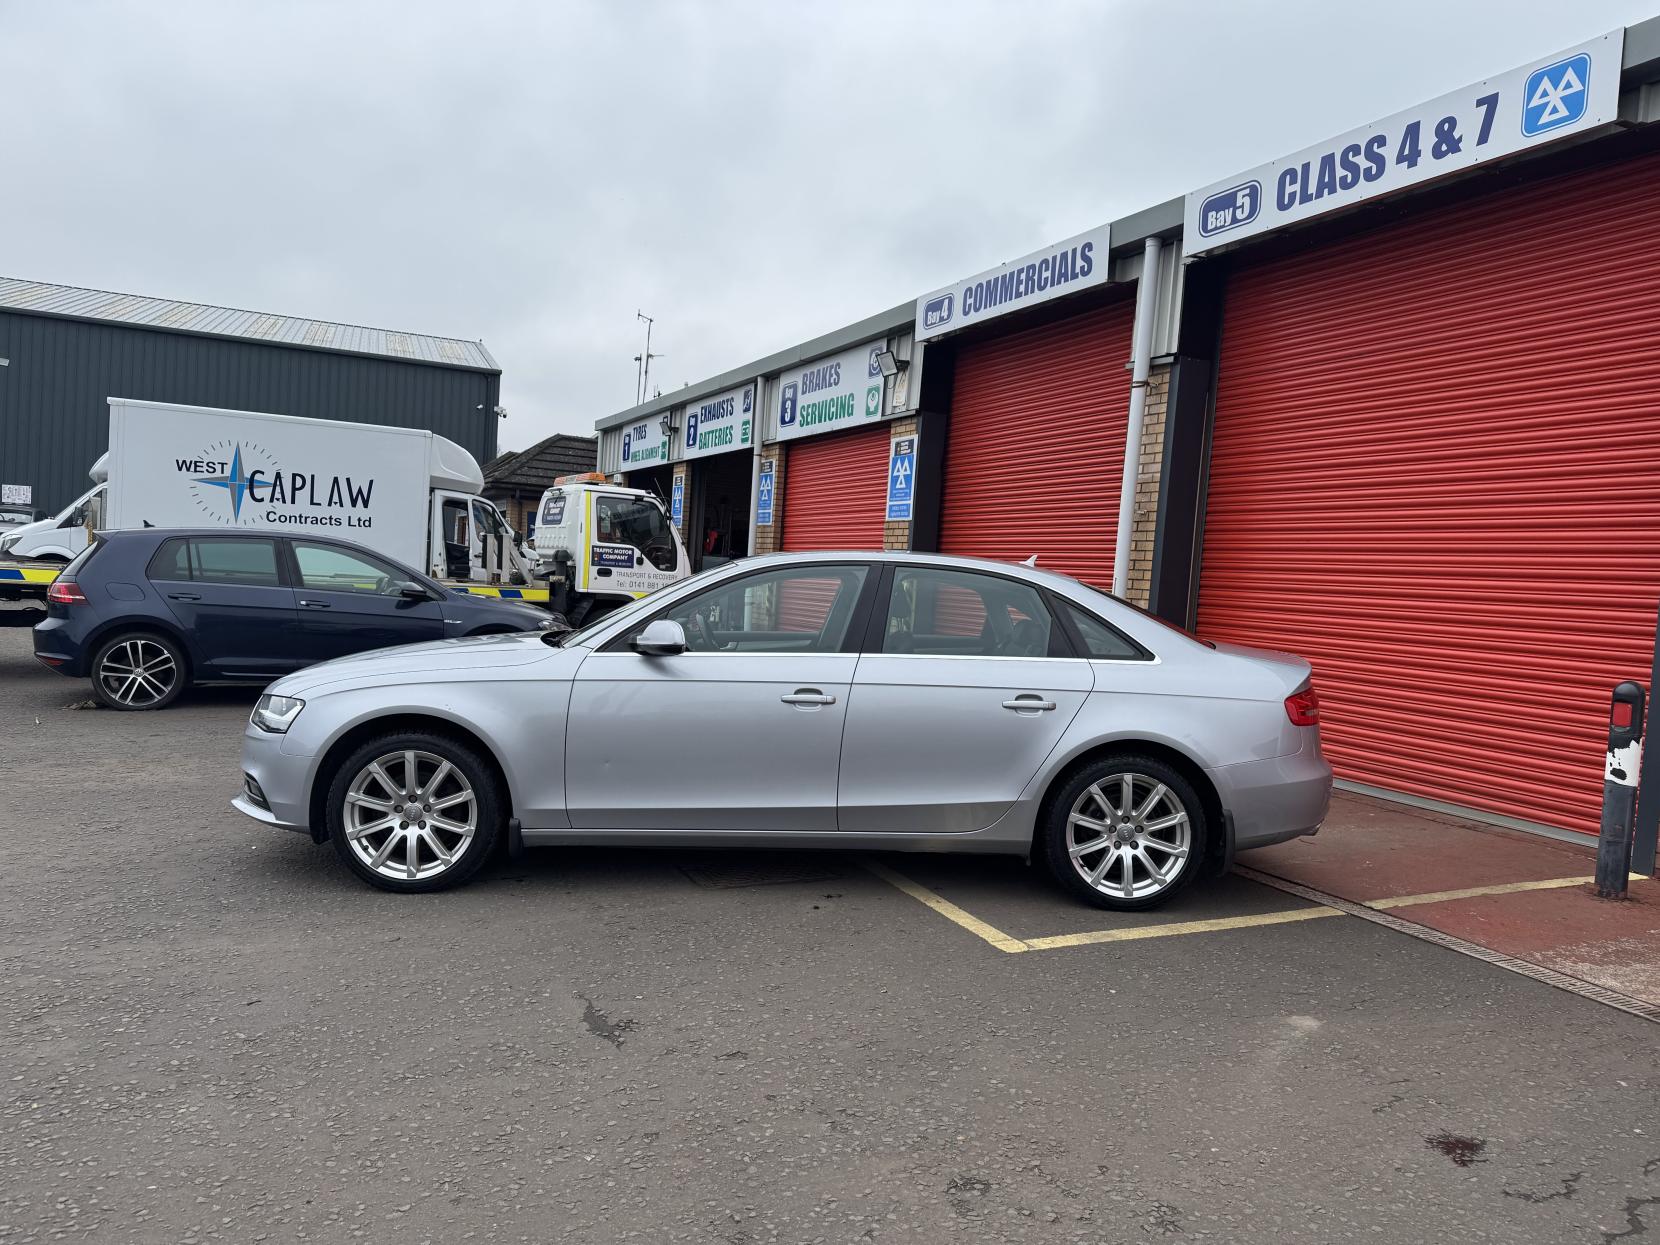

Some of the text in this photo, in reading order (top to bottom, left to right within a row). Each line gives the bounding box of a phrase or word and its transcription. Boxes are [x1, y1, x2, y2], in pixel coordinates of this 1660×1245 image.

[1207, 91, 1500, 231] Bay 5 CLASS 4 & 7
[927, 242, 1094, 325] Bay 4 COMMERCIALS
[801, 362, 841, 396] BRAKES
[700, 396, 734, 424] EXHAUSTS
[784, 399, 792, 422] 3
[799, 393, 855, 428] SERVICING
[633, 423, 648, 442] TYRES
[688, 427, 695, 445] 2
[698, 425, 733, 450] BATTERIES
[175, 459, 229, 475] WEST
[249, 469, 374, 509] CAPLAW
[266, 511, 372, 528] Contracts Ltd
[616, 571, 646, 579] TRANSPORT
[652, 573, 678, 581] RECOVERY
